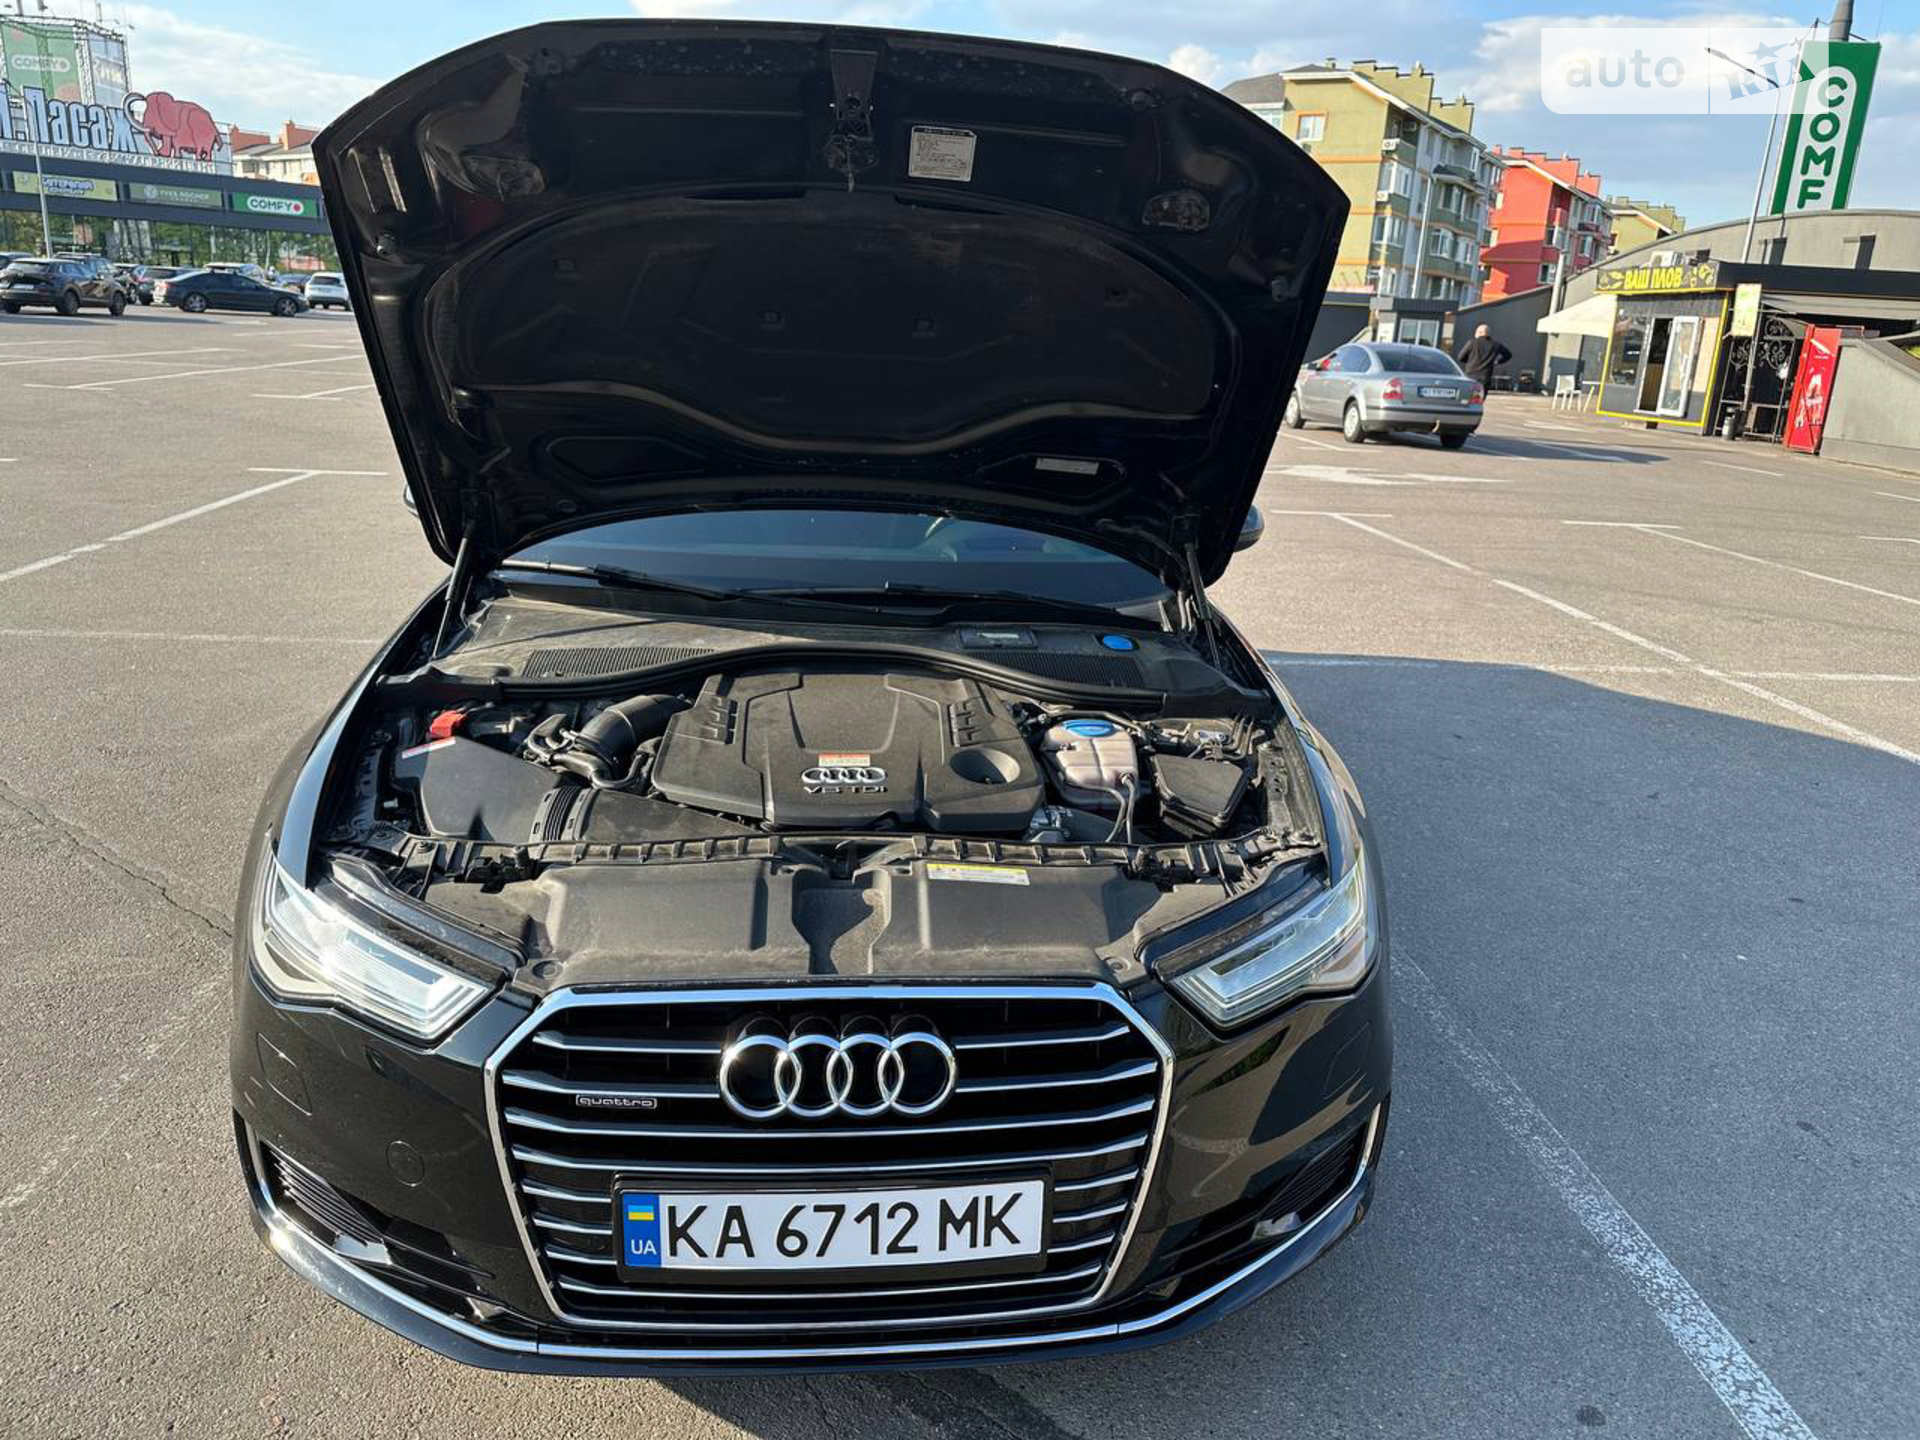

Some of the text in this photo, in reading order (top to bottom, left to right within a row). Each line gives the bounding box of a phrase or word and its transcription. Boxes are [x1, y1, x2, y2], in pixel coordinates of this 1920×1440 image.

[249, 198, 292, 211] COMFY
[579, 1096, 654, 1108] quattro
[666, 1192, 1024, 1259] KA 6712 MK
[630, 1239, 657, 1256] UA
